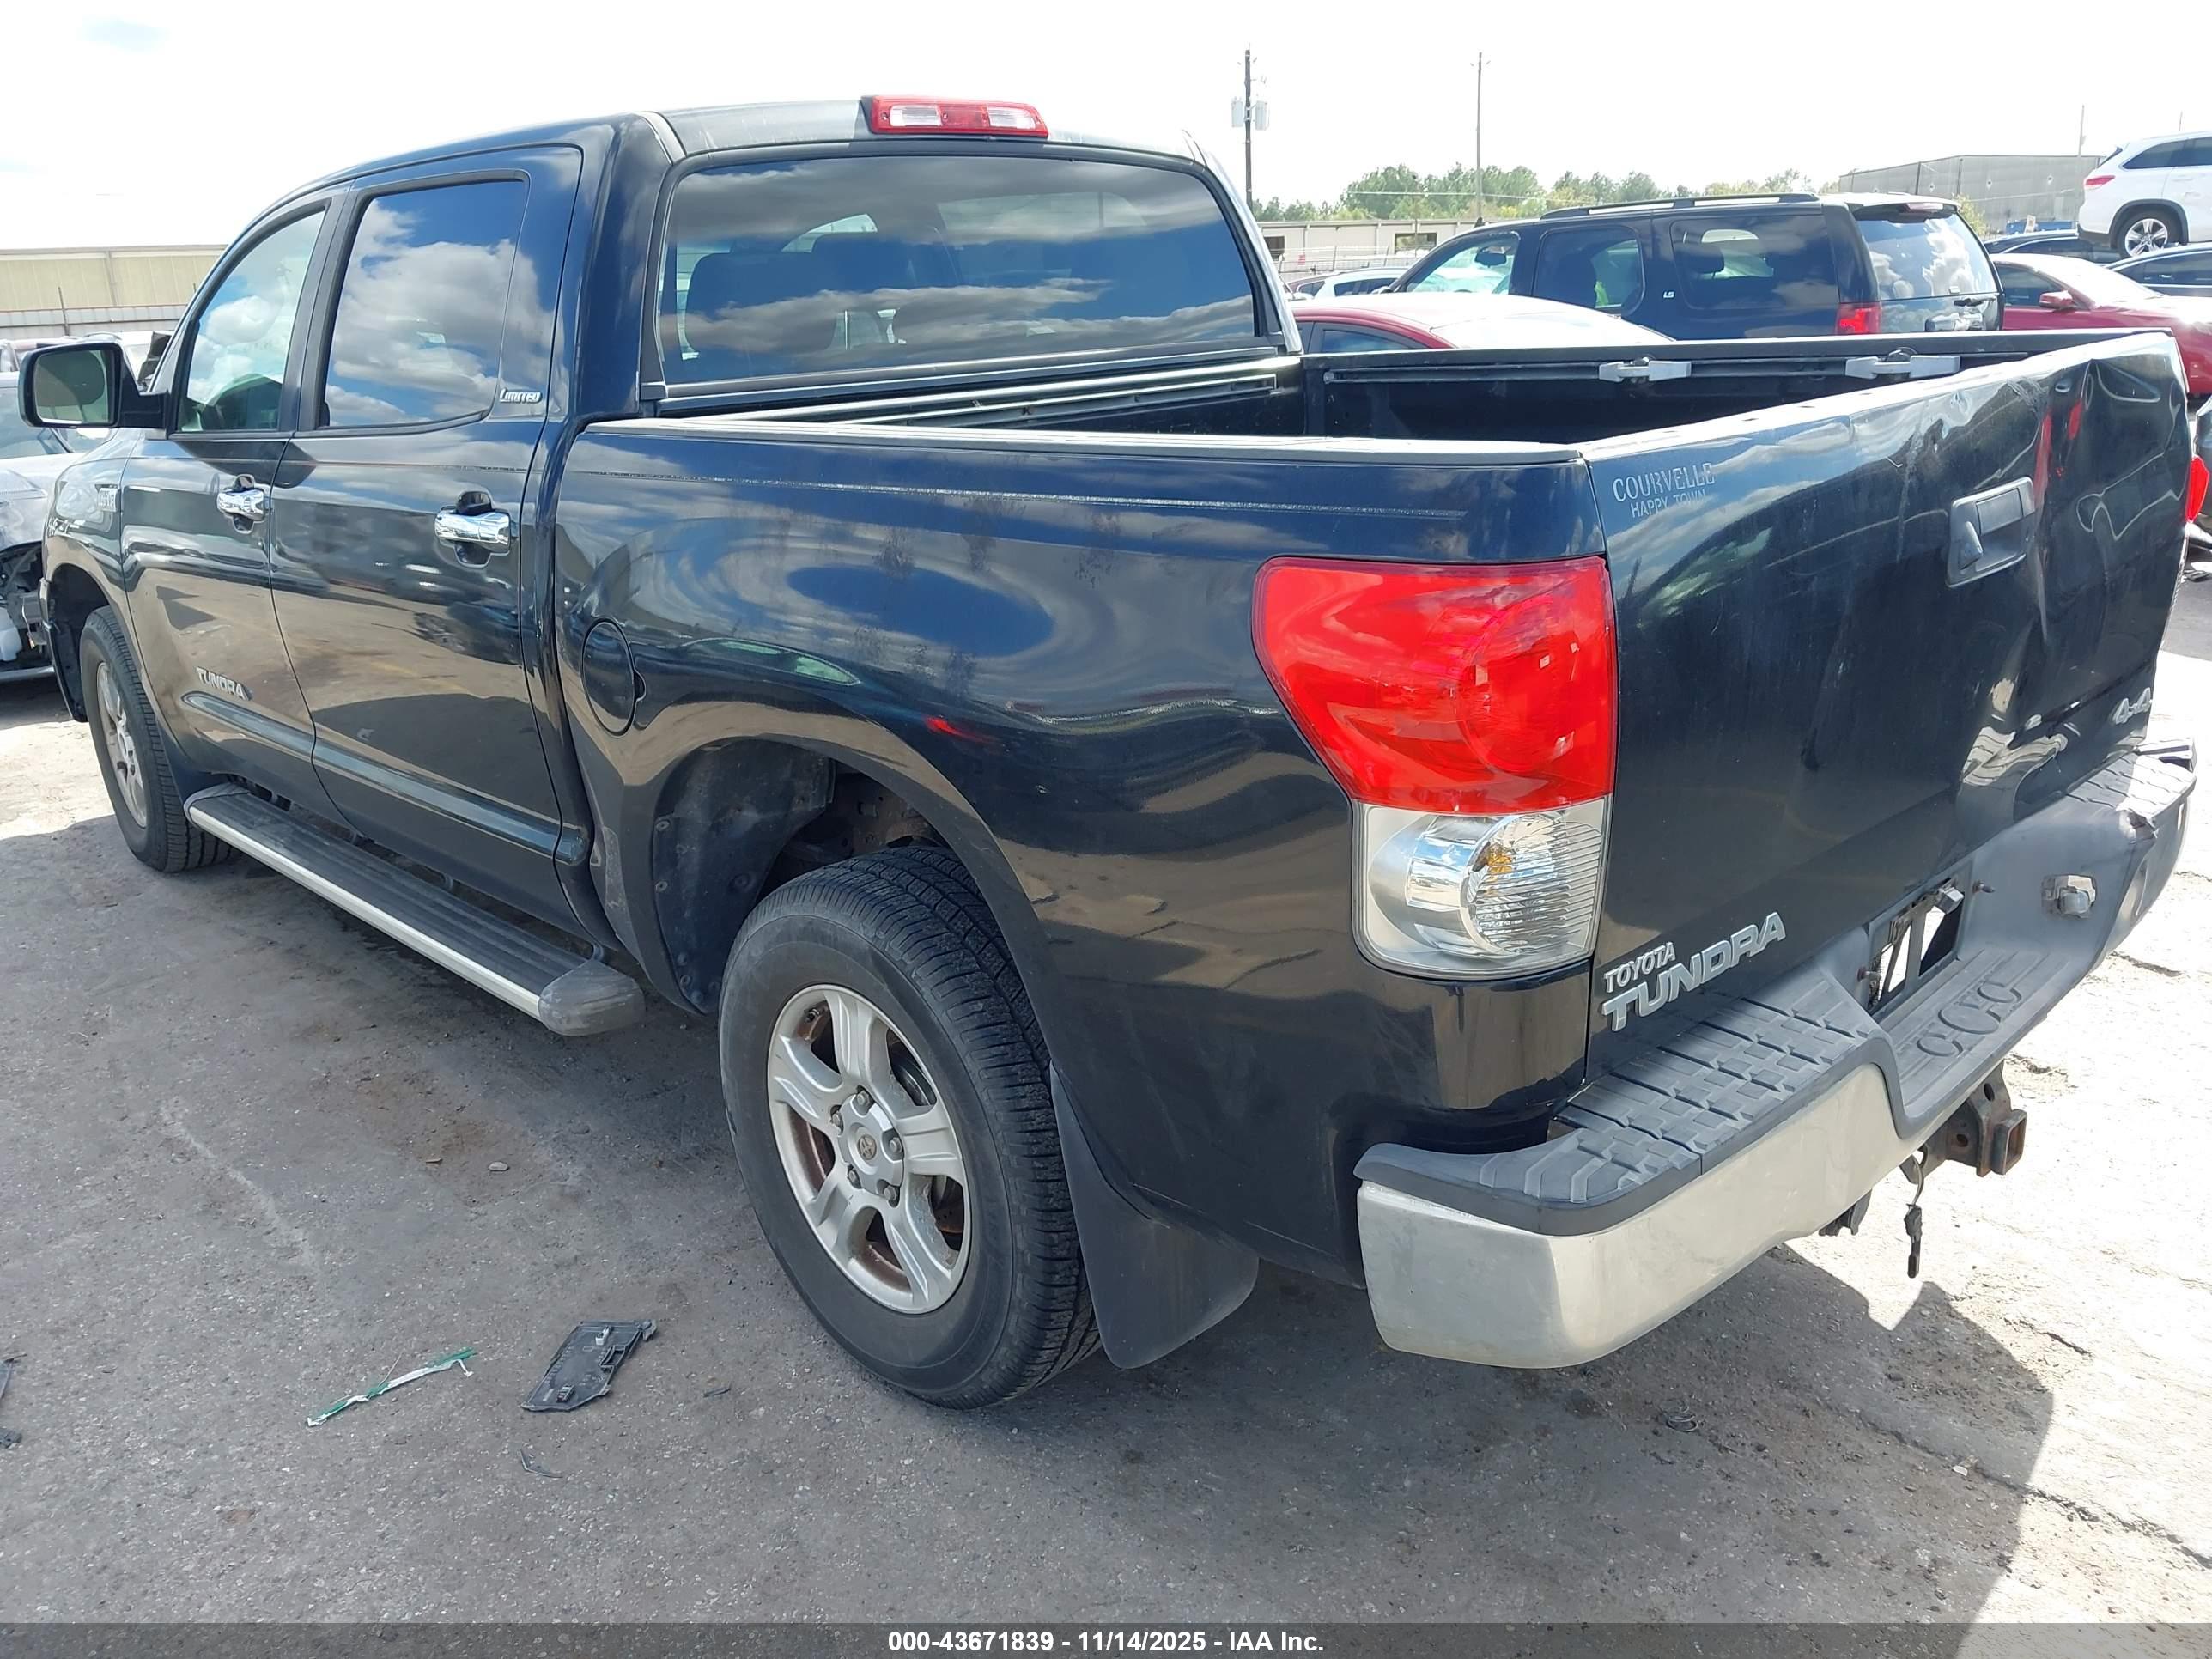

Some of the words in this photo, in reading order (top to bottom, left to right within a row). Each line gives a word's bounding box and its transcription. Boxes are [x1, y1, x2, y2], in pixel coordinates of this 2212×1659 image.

[1613, 462, 1716, 502] COURVELLE
[1630, 496, 1668, 518] HAPPY
[1673, 489, 1706, 507] TOWN
[195, 666, 249, 701] TUNDRA
[1601, 911, 1786, 1032] TUNDRA
[1604, 941, 1676, 993] TOYOTA
